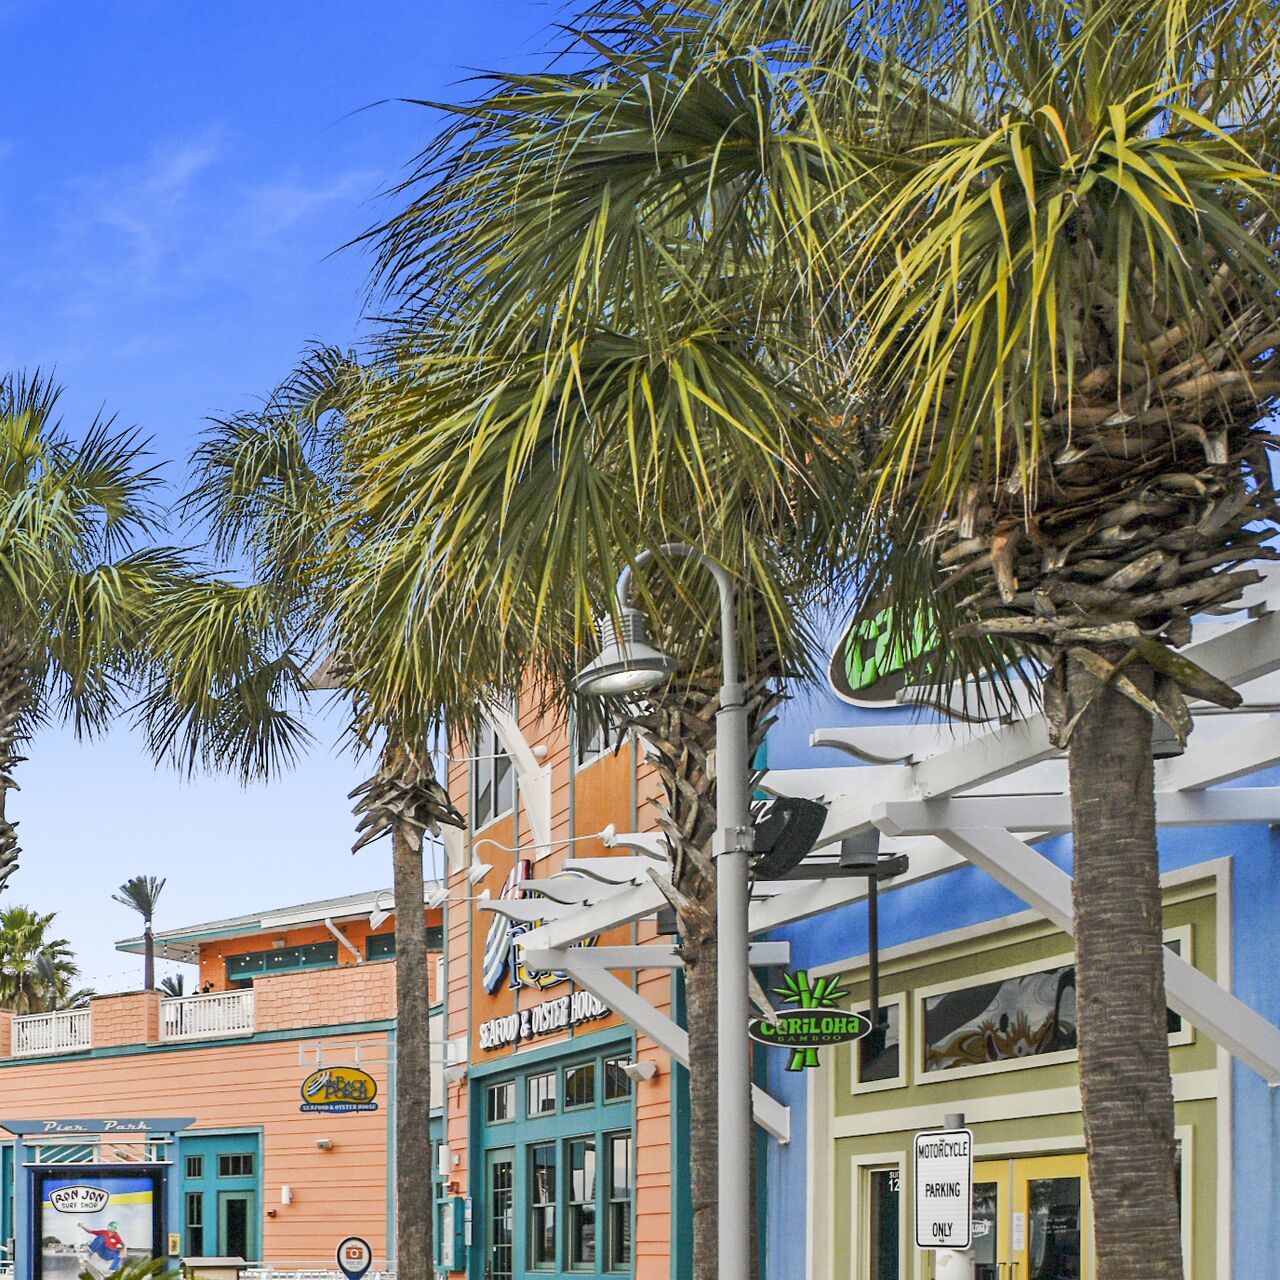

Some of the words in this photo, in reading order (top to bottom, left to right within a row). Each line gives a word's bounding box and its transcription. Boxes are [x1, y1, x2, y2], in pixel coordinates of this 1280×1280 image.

[479, 1013, 520, 1050] SEAFOOD
[520, 1011, 532, 1038] &
[531, 996, 569, 1034] OYSTER
[42, 1121, 88, 1131] Pier
[103, 1120, 152, 1131] Park
[918, 1141, 968, 1159] MOTORCYCLE
[55, 1190, 79, 1203] RON
[81, 1190, 105, 1202] JON
[925, 1182, 960, 1198] PARKING
[932, 1222, 953, 1238] ONLY
